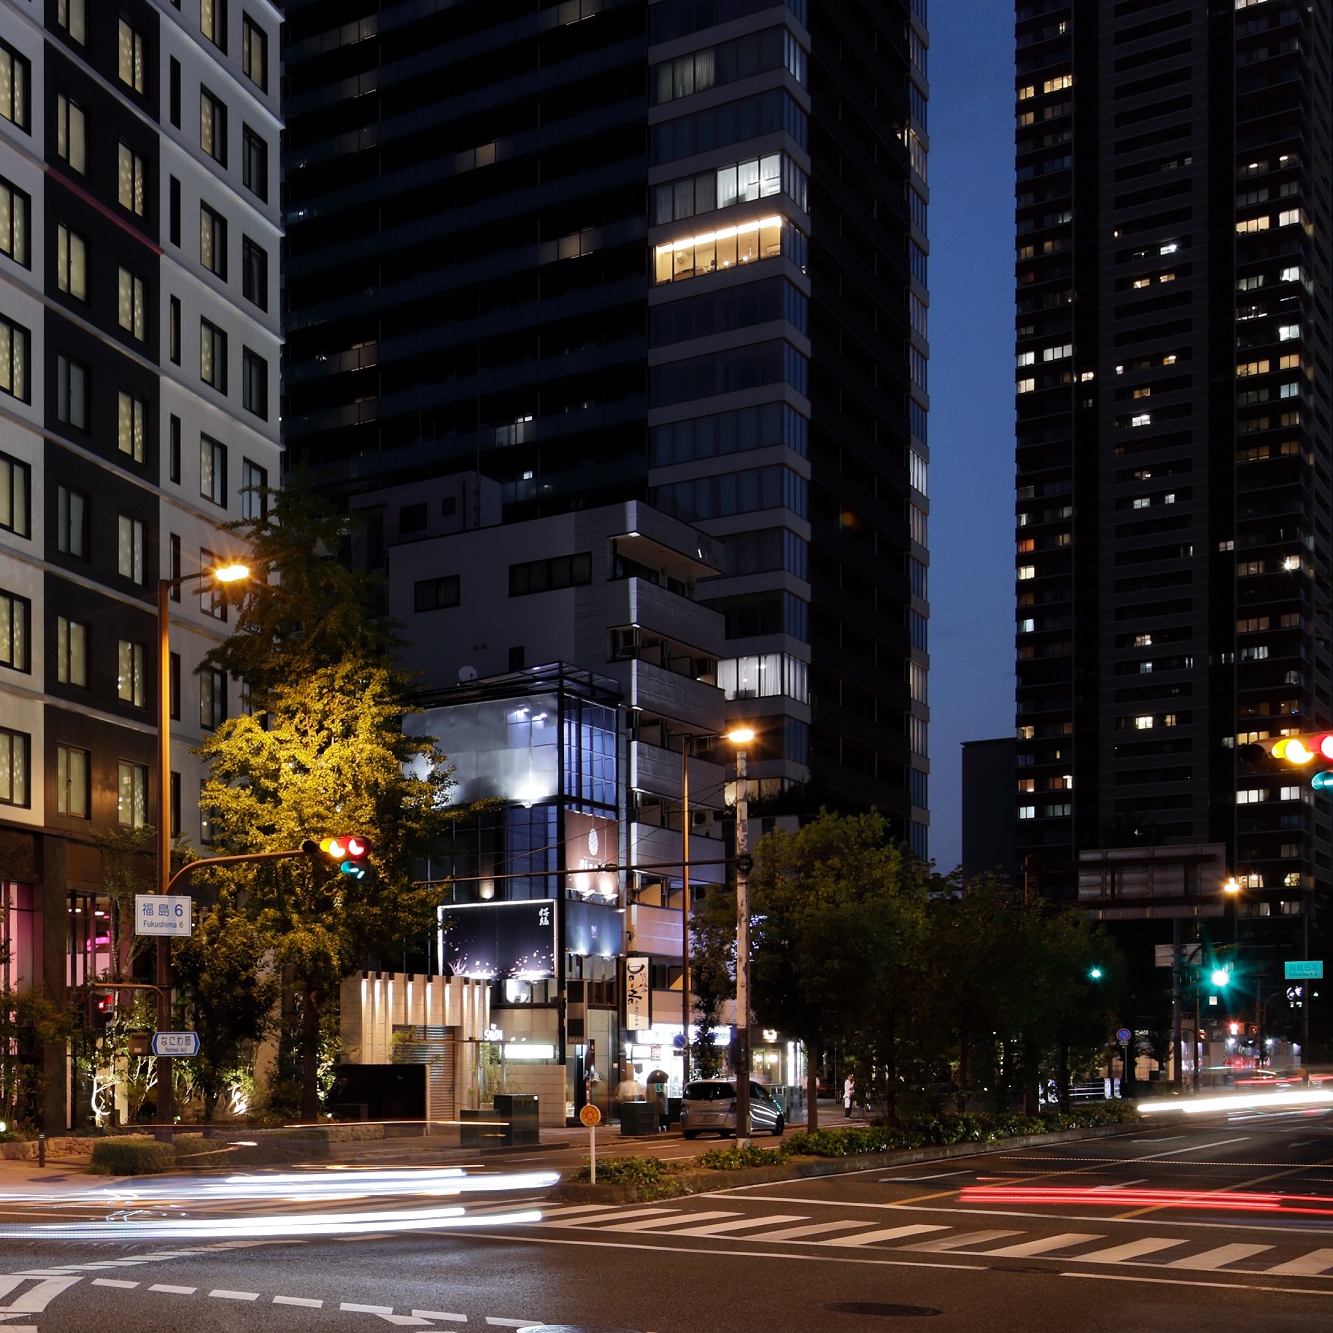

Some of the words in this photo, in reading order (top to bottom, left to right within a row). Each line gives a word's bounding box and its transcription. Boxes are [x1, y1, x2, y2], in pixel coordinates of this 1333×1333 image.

[143, 919, 177, 929] Fukushima
[179, 921, 184, 929] 6
[160, 1035, 192, 1047] なにわ筋
